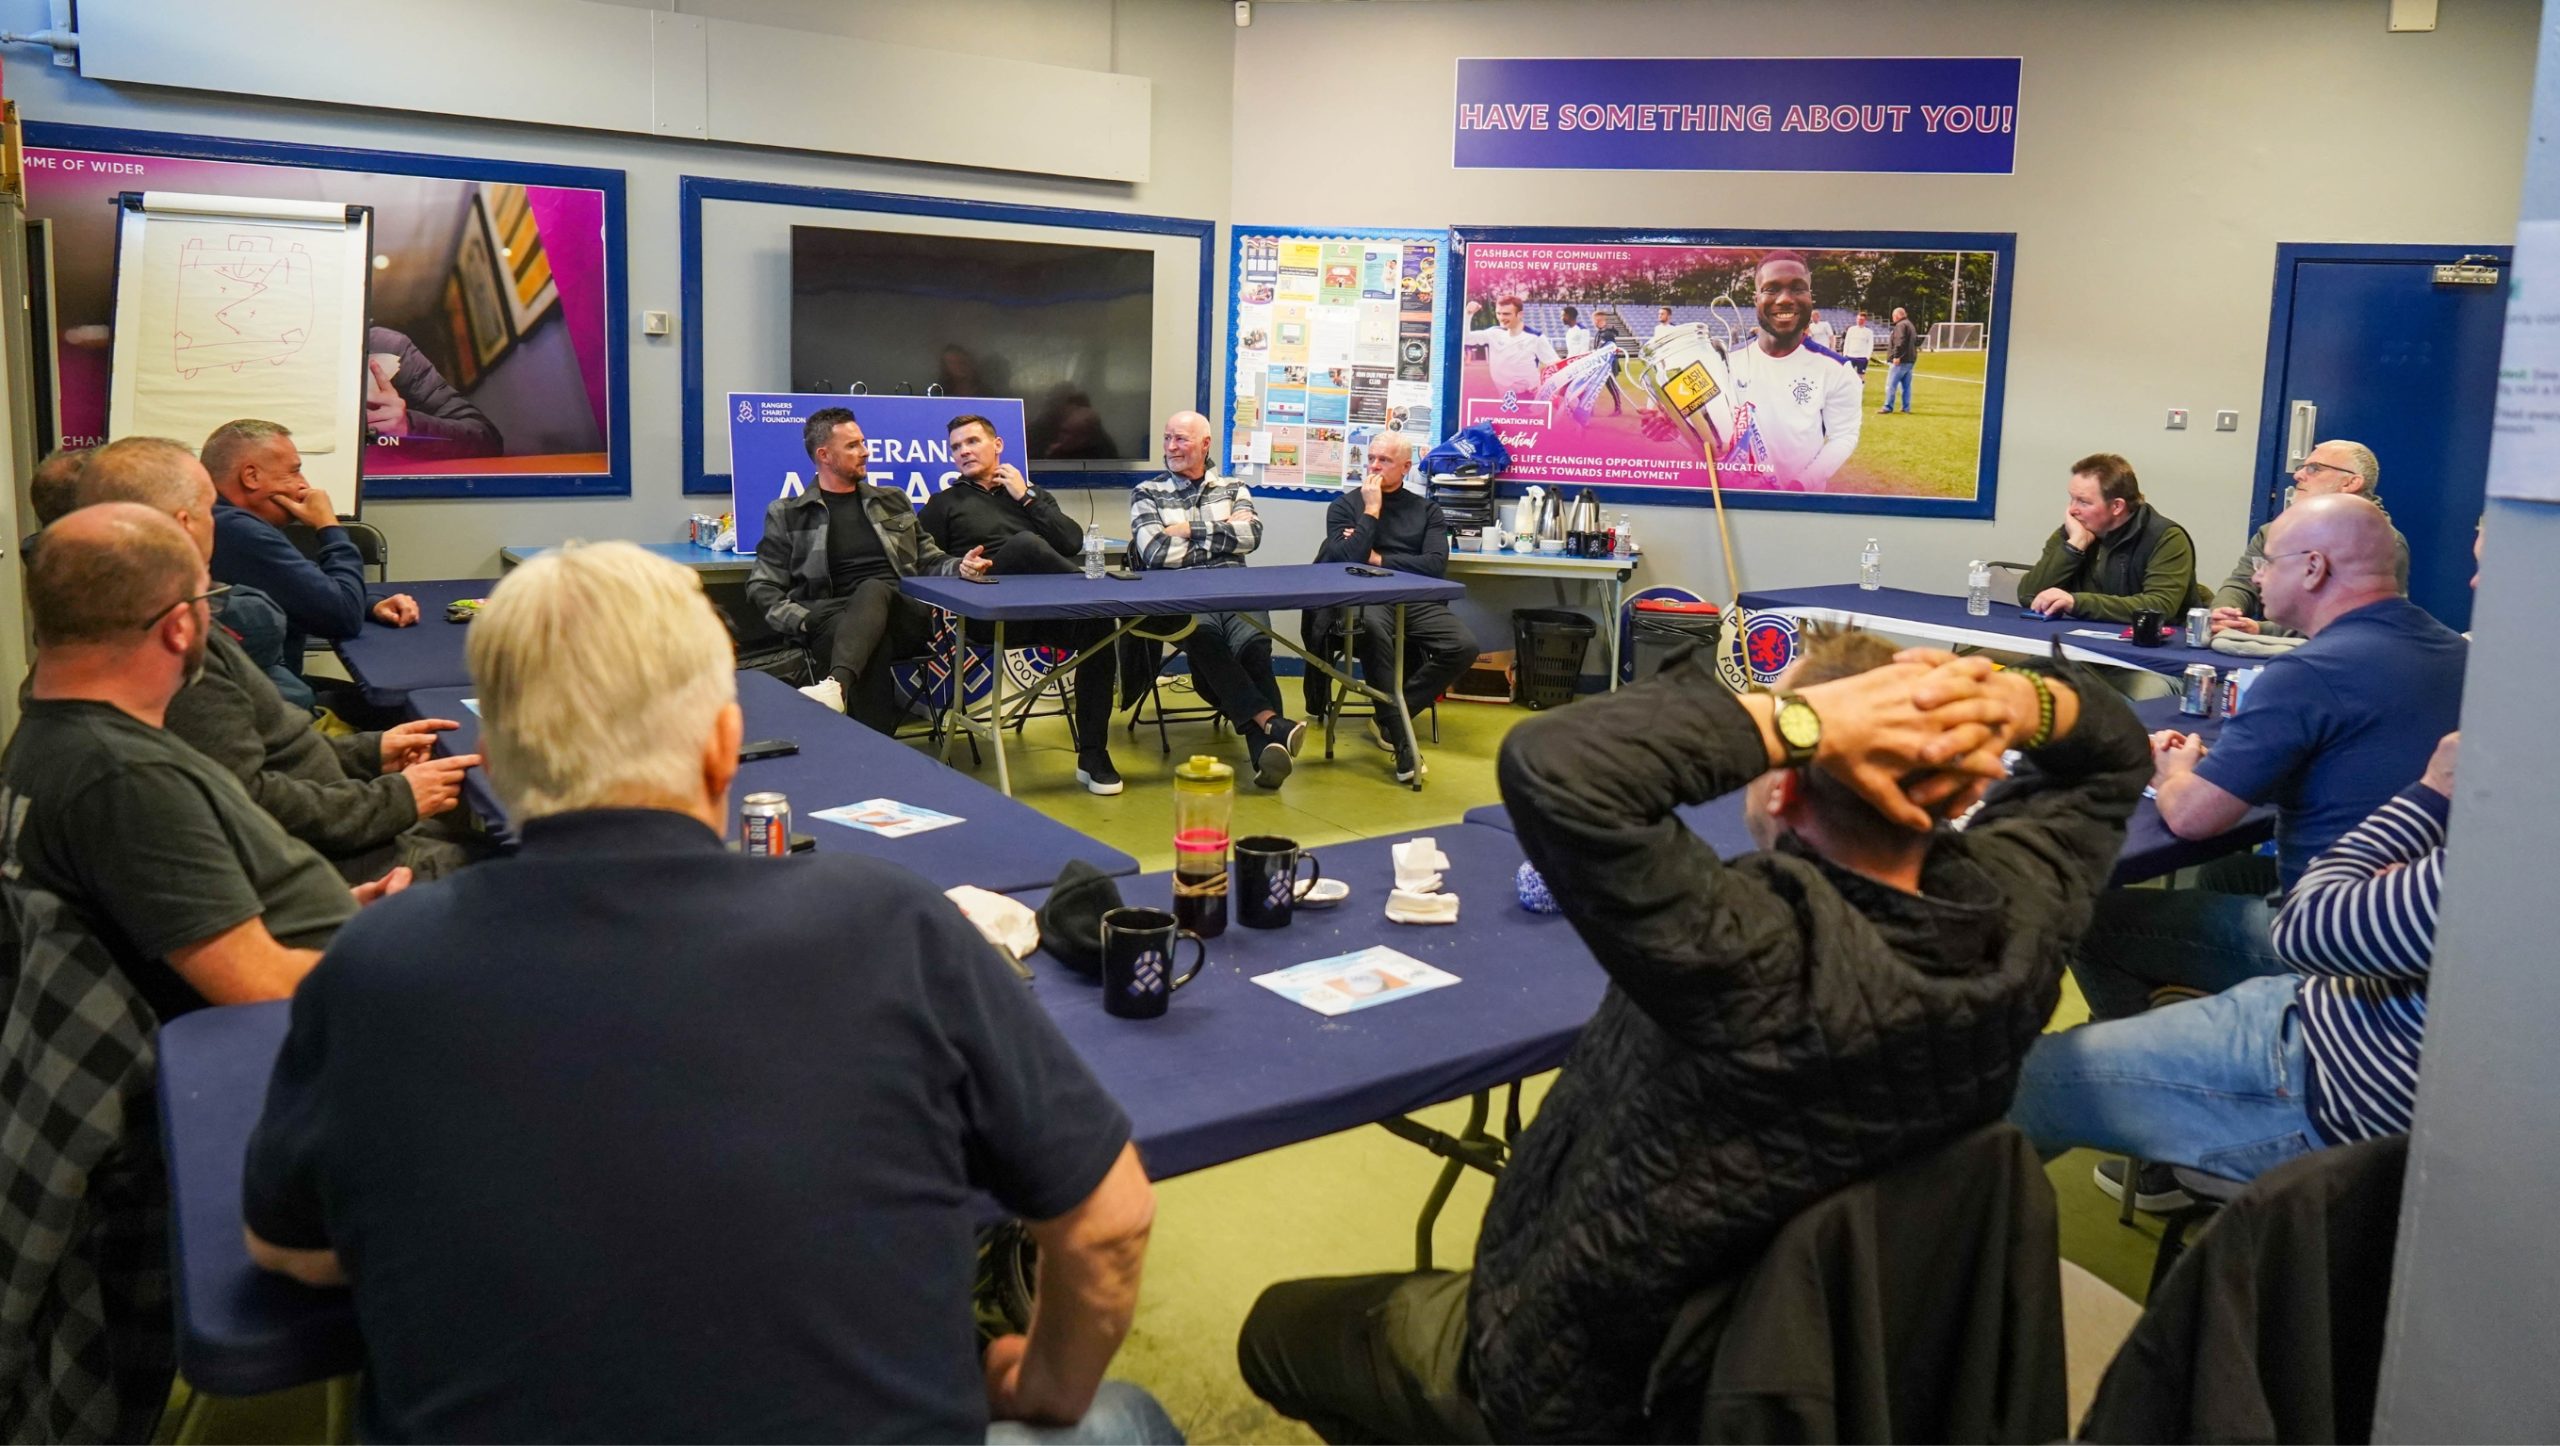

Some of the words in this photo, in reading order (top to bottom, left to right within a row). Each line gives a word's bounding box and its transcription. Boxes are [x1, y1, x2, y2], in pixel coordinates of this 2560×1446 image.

[1459, 104, 1549, 130] HAVE
[1558, 104, 1771, 132] SOMETHING
[1781, 105, 1911, 132] ABOUT
[1921, 105, 2013, 133] YOU!
[62, 159, 85, 170] OF
[91, 161, 145, 175] WIDER
[1474, 249, 1529, 258] CASHBACK
[1532, 250, 1553, 258] FOR
[1556, 251, 1631, 260] COMMUNITIES:
[1474, 260, 1524, 270] TOWARDS
[1527, 262, 1550, 270] NEW
[1553, 262, 1598, 271] FUTURES
[1529, 418, 1545, 426] FOR
[1521, 454, 1543, 463] LIFE
[1545, 455, 1603, 466] CHANGING
[1605, 458, 1693, 470] OPPORTUNITIES
[1695, 461, 1707, 470] IN
[1550, 467, 1603, 478] TOWARDS
[1605, 469, 1680, 481] EMPLOYMENT
